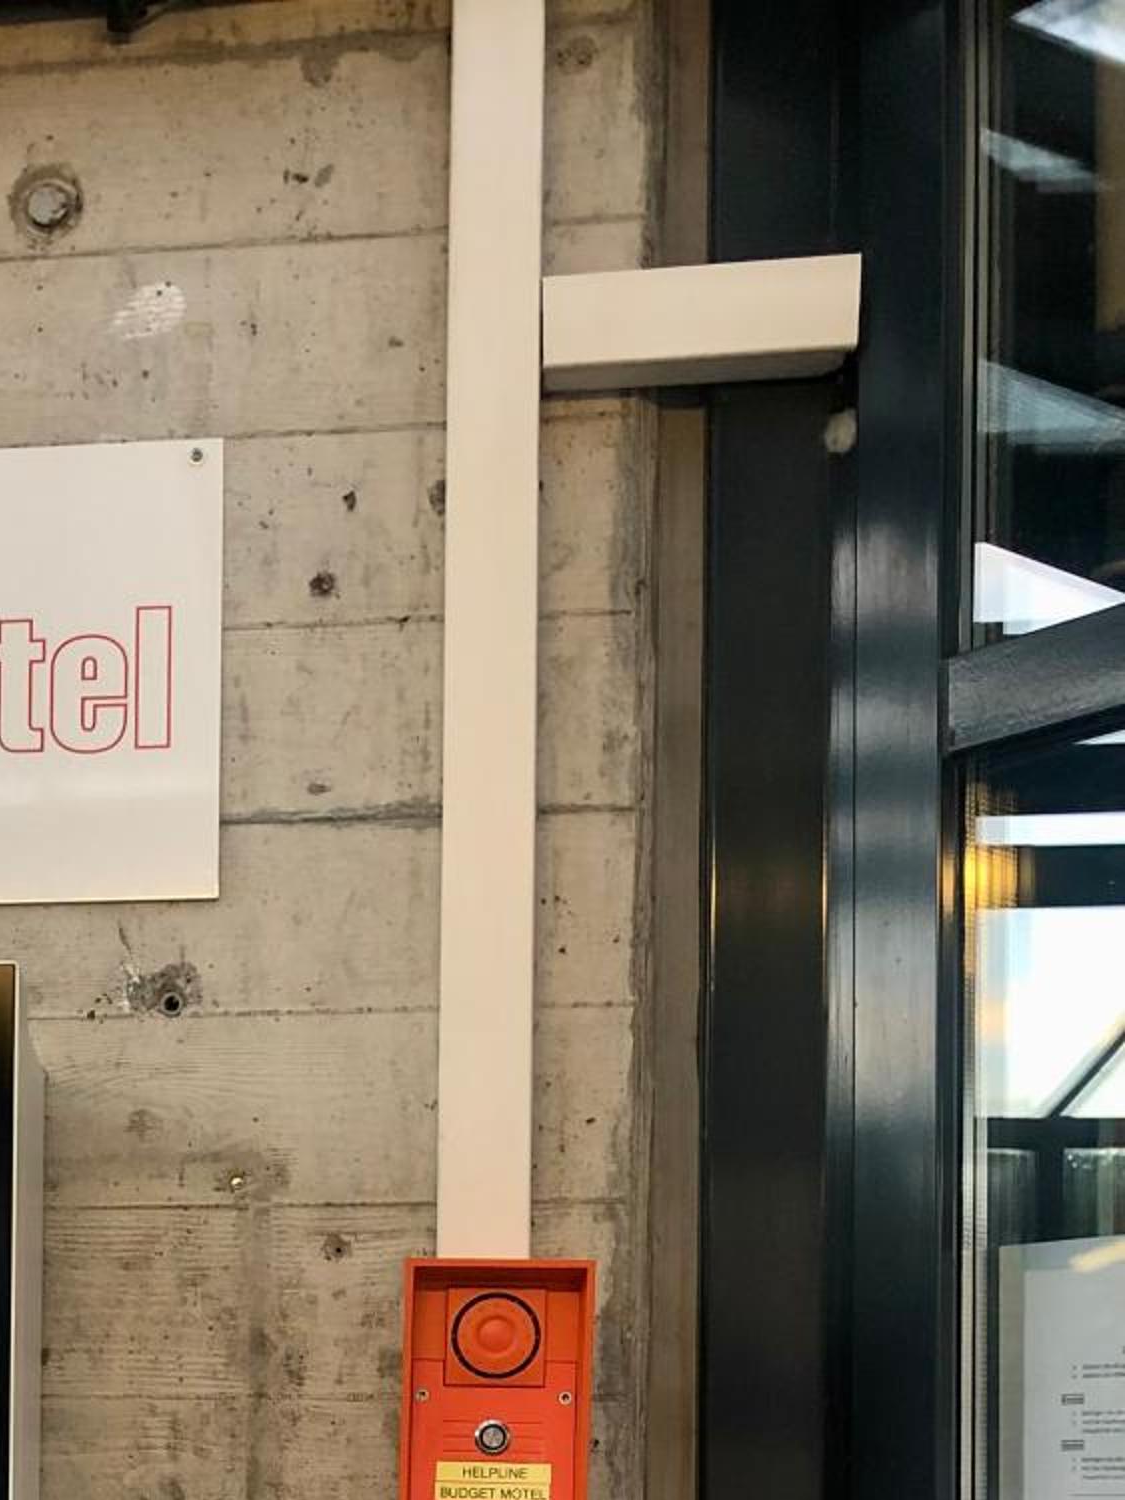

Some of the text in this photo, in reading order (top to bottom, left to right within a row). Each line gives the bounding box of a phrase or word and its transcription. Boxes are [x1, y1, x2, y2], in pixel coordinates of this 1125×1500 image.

[462, 1465, 528, 1479] HELPLINE
[439, 1487, 548, 1500] BUDGET MOTEL
